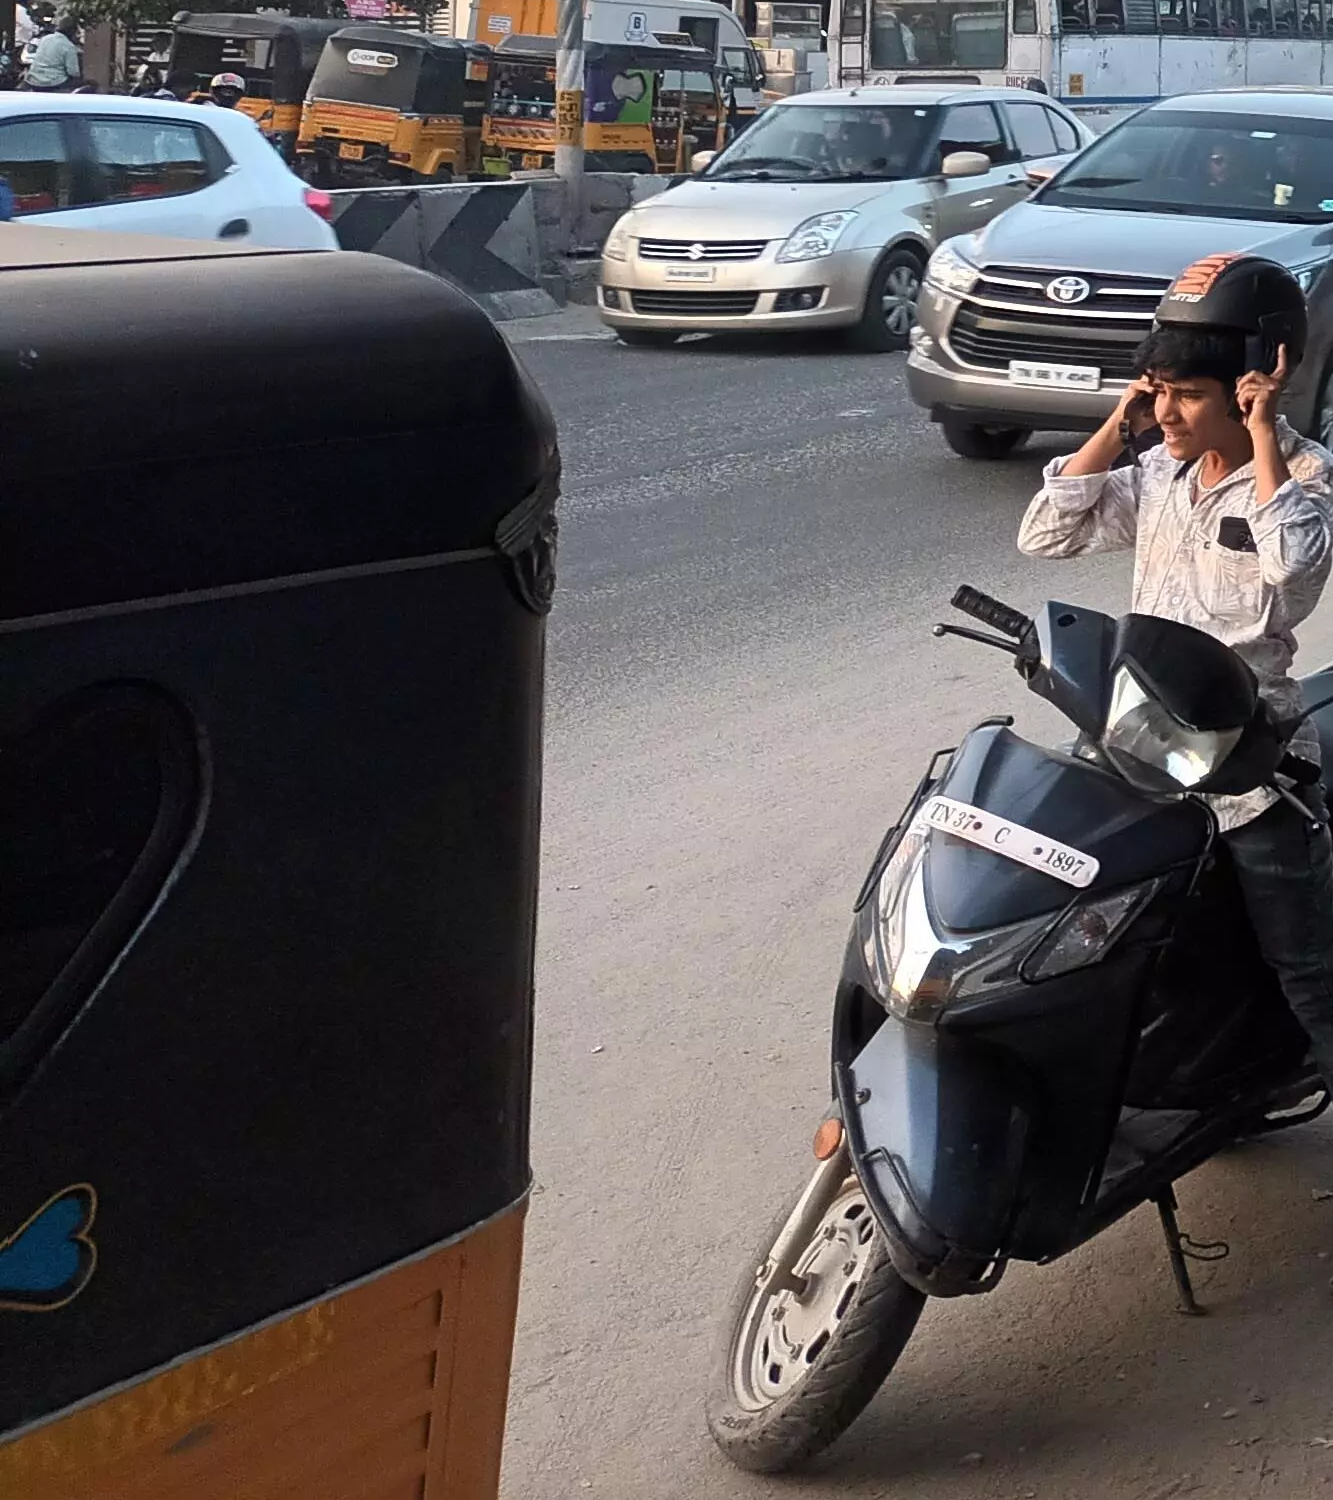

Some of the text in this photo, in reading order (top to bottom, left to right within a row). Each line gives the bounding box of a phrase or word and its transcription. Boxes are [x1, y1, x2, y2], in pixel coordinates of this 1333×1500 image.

[930, 802, 1087, 877] TN 37 C 1897
